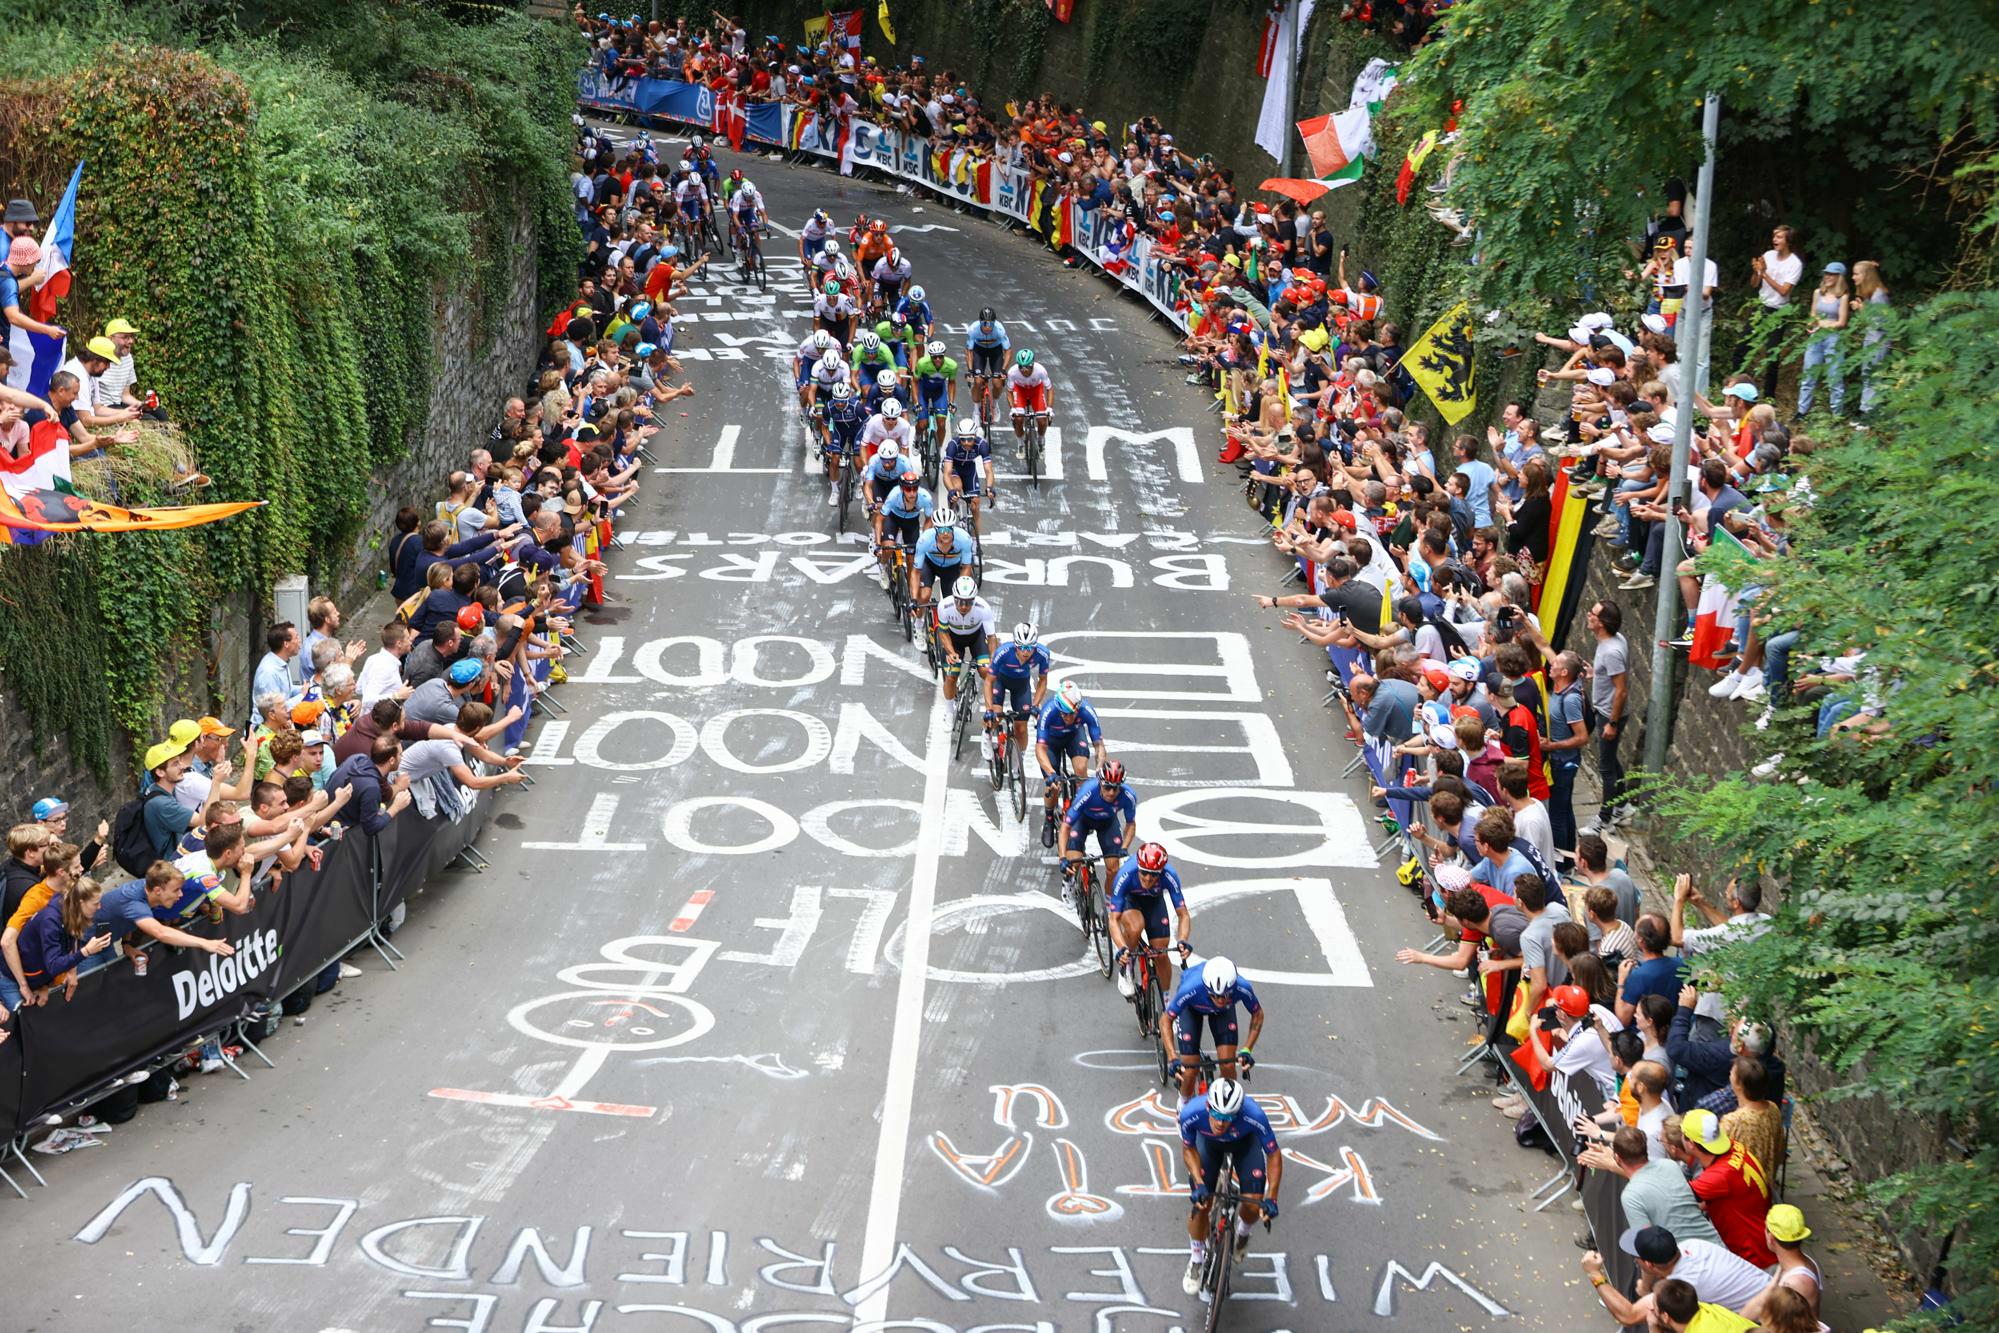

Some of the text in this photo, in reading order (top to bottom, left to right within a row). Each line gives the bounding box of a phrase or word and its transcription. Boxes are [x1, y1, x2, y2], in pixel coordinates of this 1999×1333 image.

[999, 193, 1014, 209] KBC
[565, 632, 1264, 703] BNOOT
[716, 877, 1375, 989] DOLF
[927, 1131, 1384, 1227] KTIA
